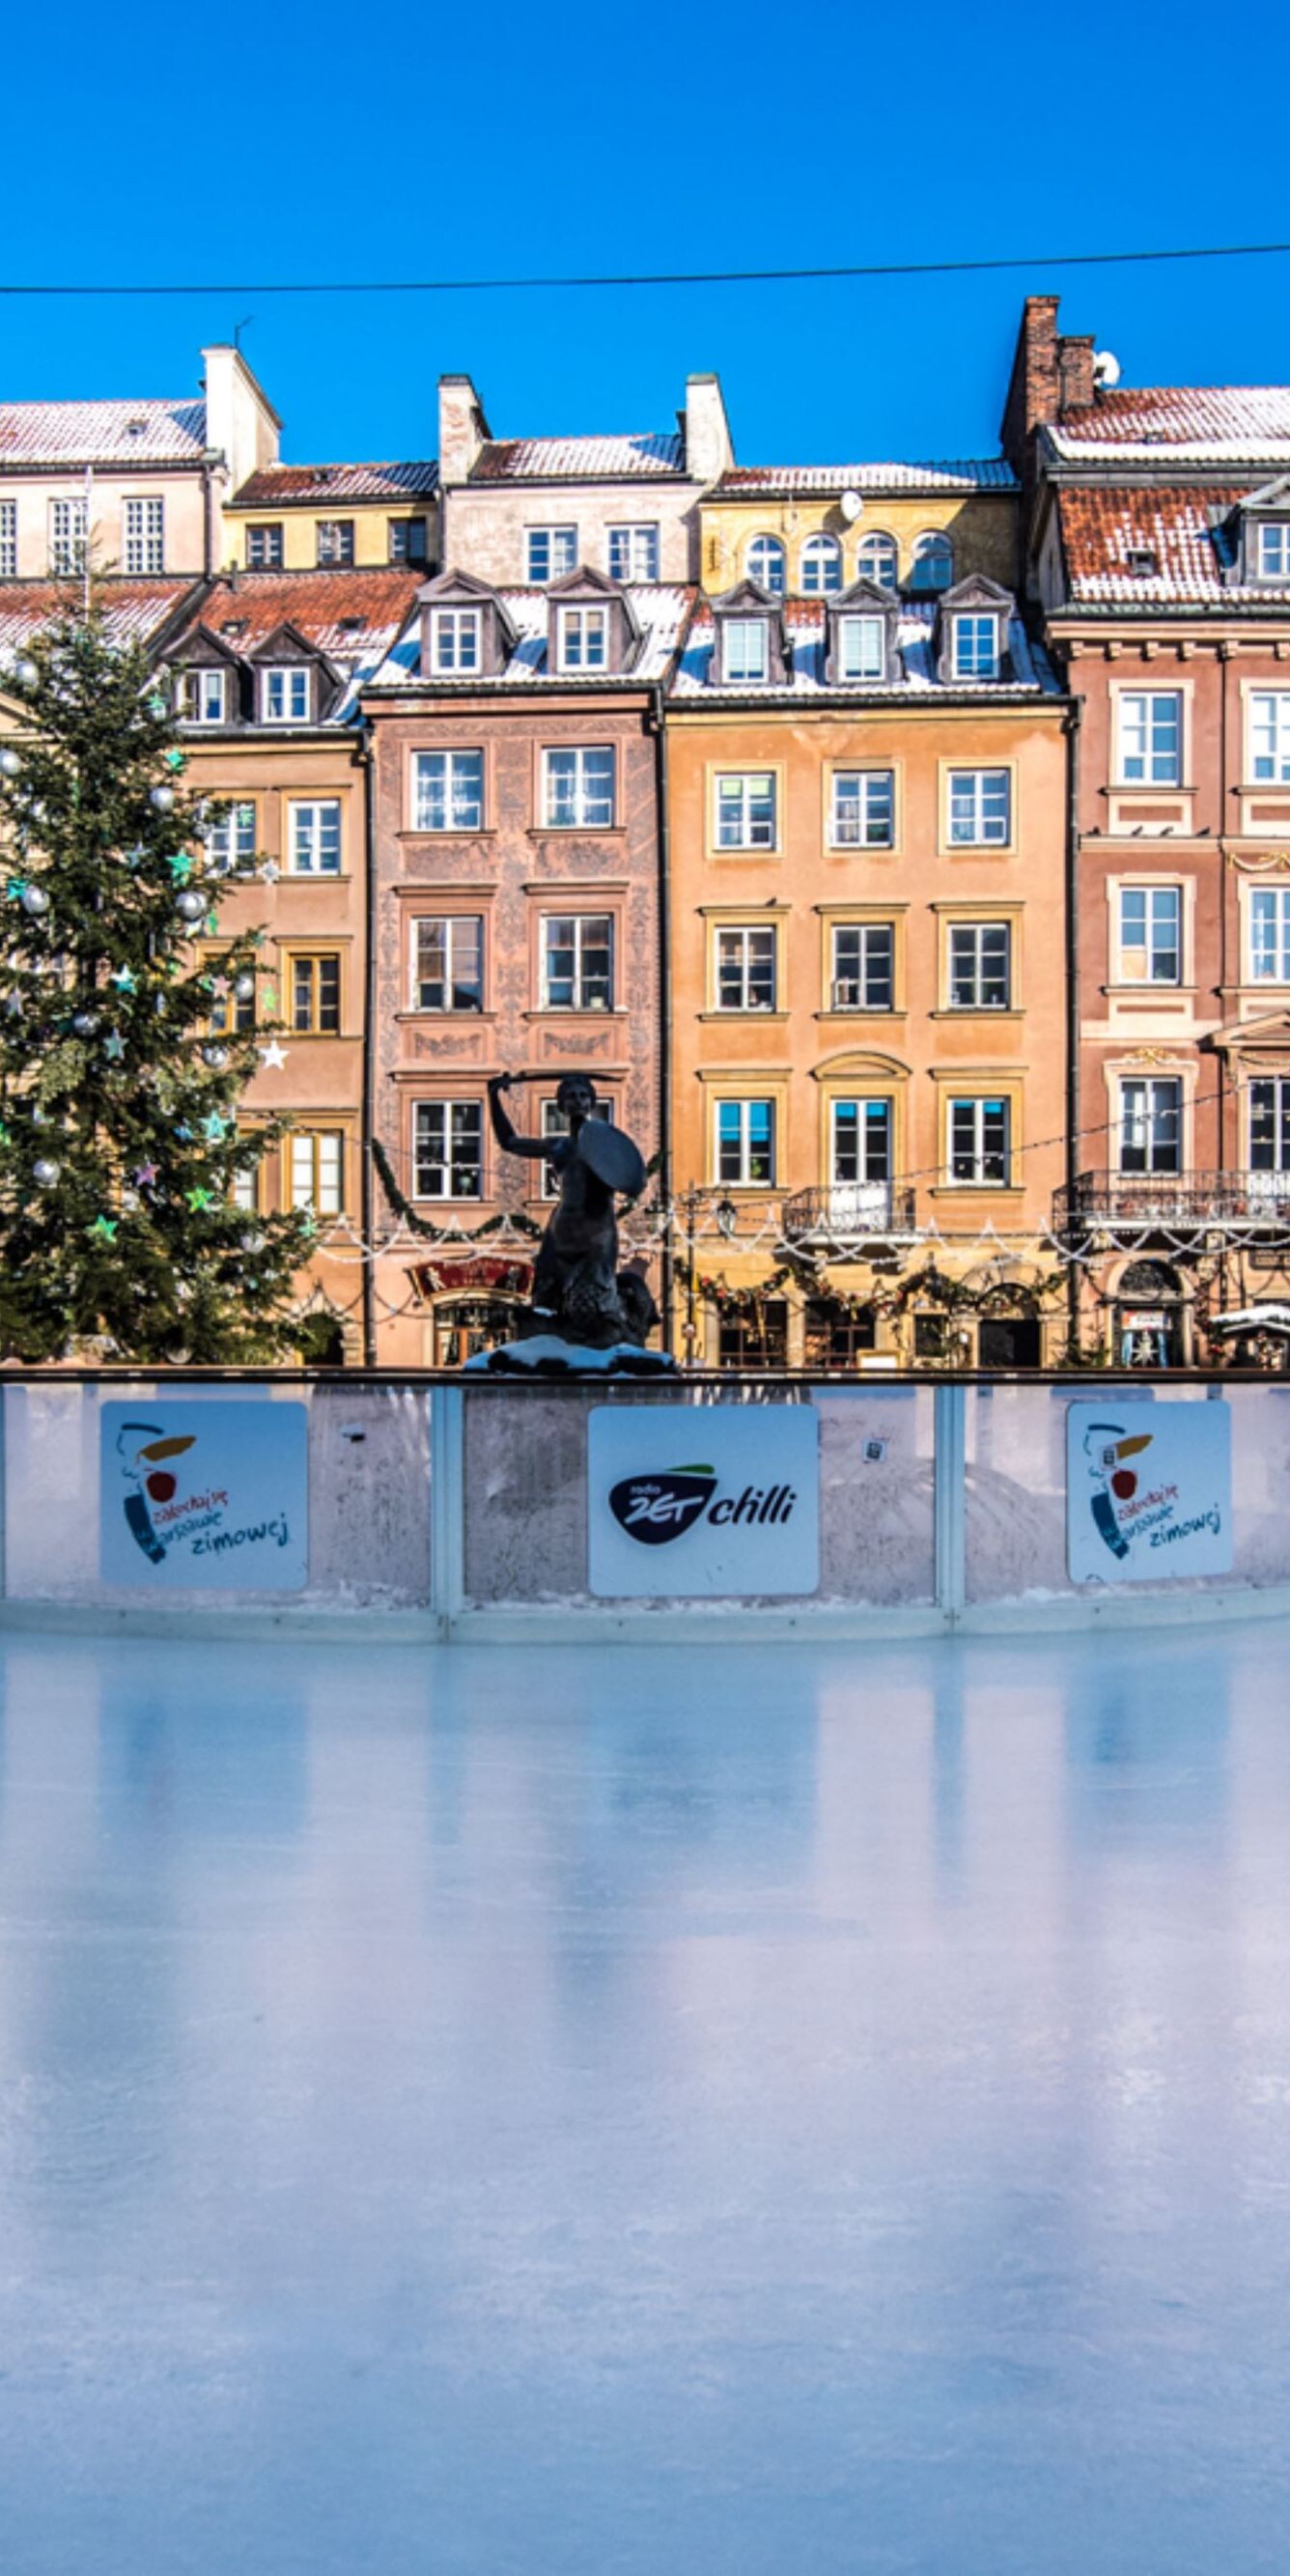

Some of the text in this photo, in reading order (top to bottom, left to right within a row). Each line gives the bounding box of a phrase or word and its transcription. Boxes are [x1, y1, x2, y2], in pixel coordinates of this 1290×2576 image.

[624, 1484, 797, 1525] ZET chilli
[631, 1483, 662, 1495] radio
[191, 1513, 288, 1554] zimowej
[1150, 1503, 1220, 1546] zimowej
